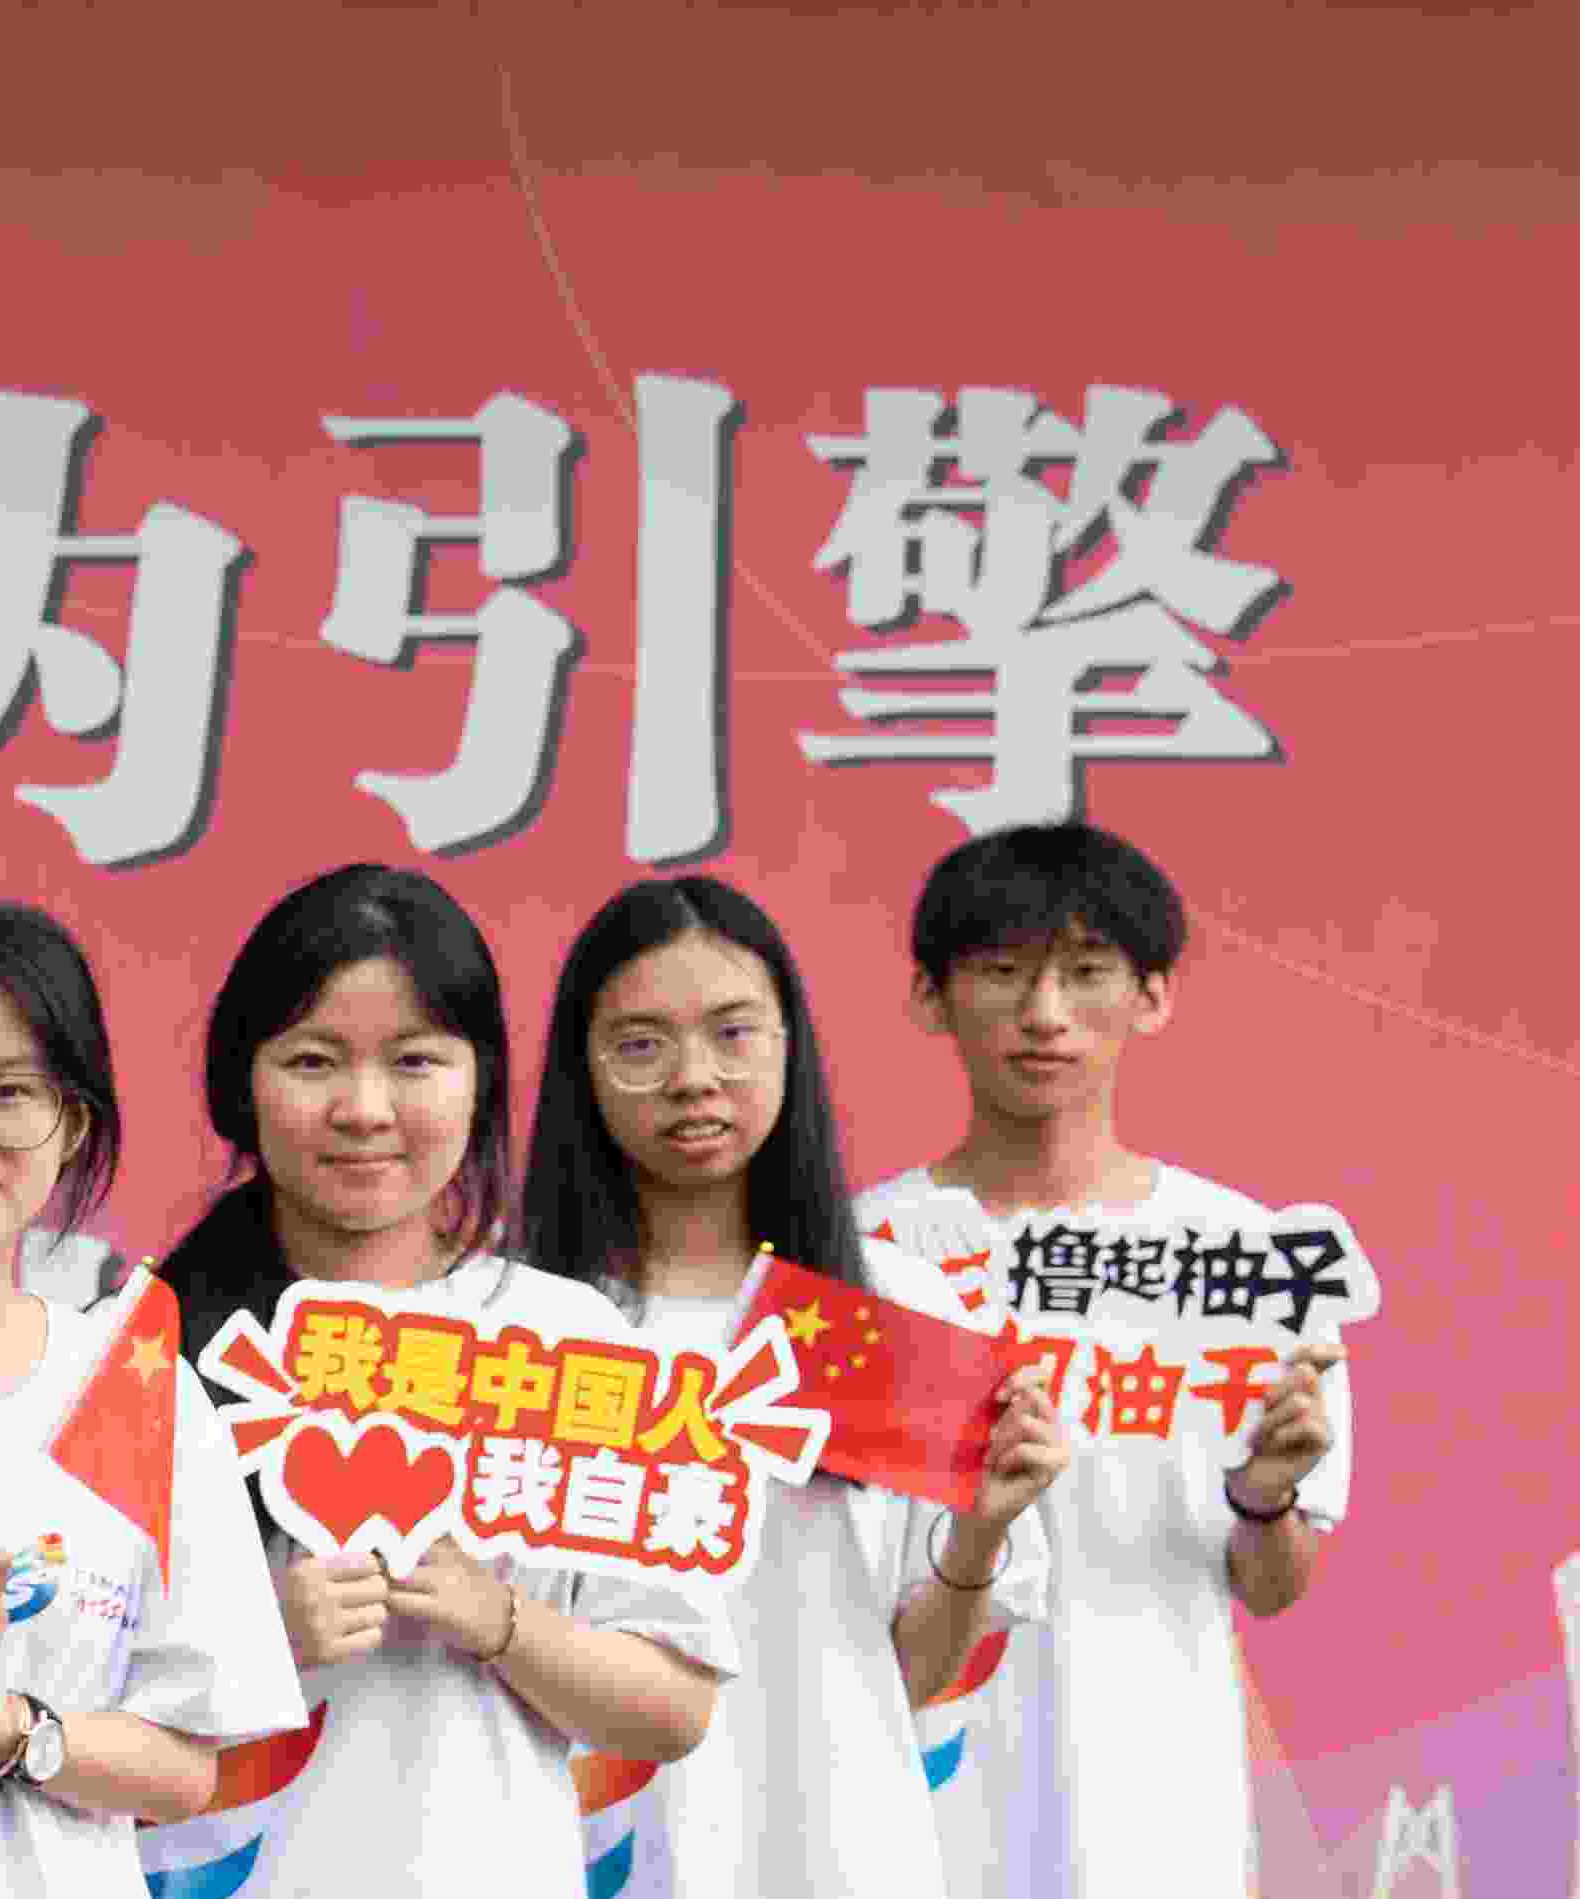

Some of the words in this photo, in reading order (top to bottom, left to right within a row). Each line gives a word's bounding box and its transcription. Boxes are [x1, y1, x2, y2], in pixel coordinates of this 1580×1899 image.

[292, 1309, 730, 1462] 我是中国人
[472, 1436, 746, 1561] 我自豪
